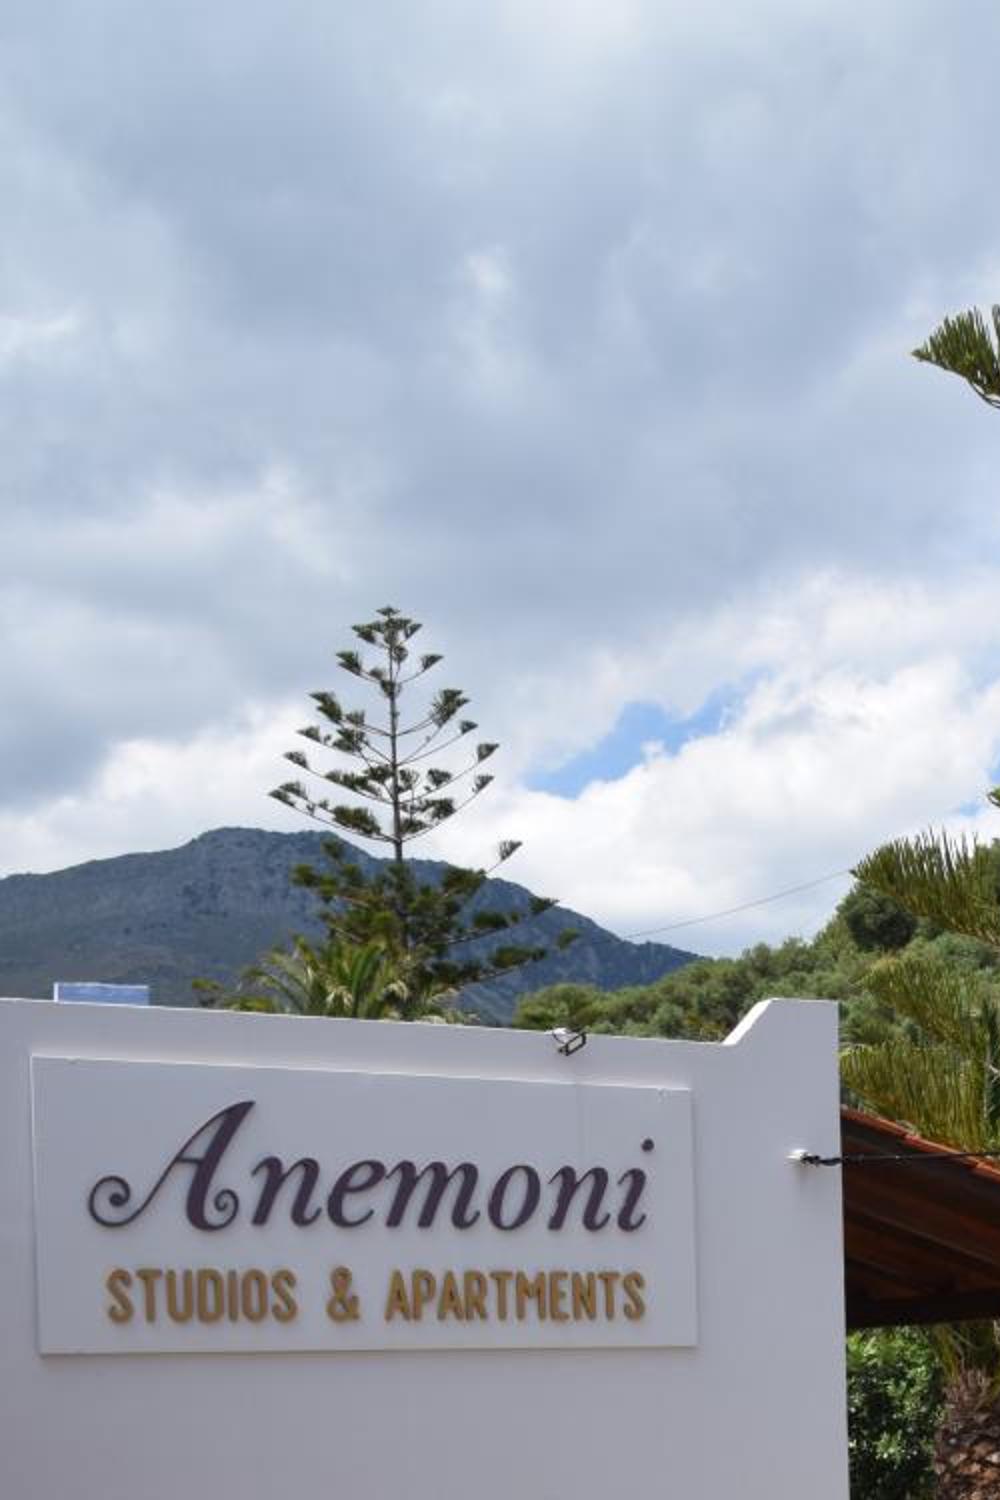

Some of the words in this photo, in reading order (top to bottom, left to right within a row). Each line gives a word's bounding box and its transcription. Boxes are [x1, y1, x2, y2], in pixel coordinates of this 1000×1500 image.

[88, 1100, 655, 1232] Anemoni
[106, 1267, 298, 1323] STUDIOS
[327, 1266, 361, 1322] &
[385, 1269, 646, 1321] APARTMENTS
